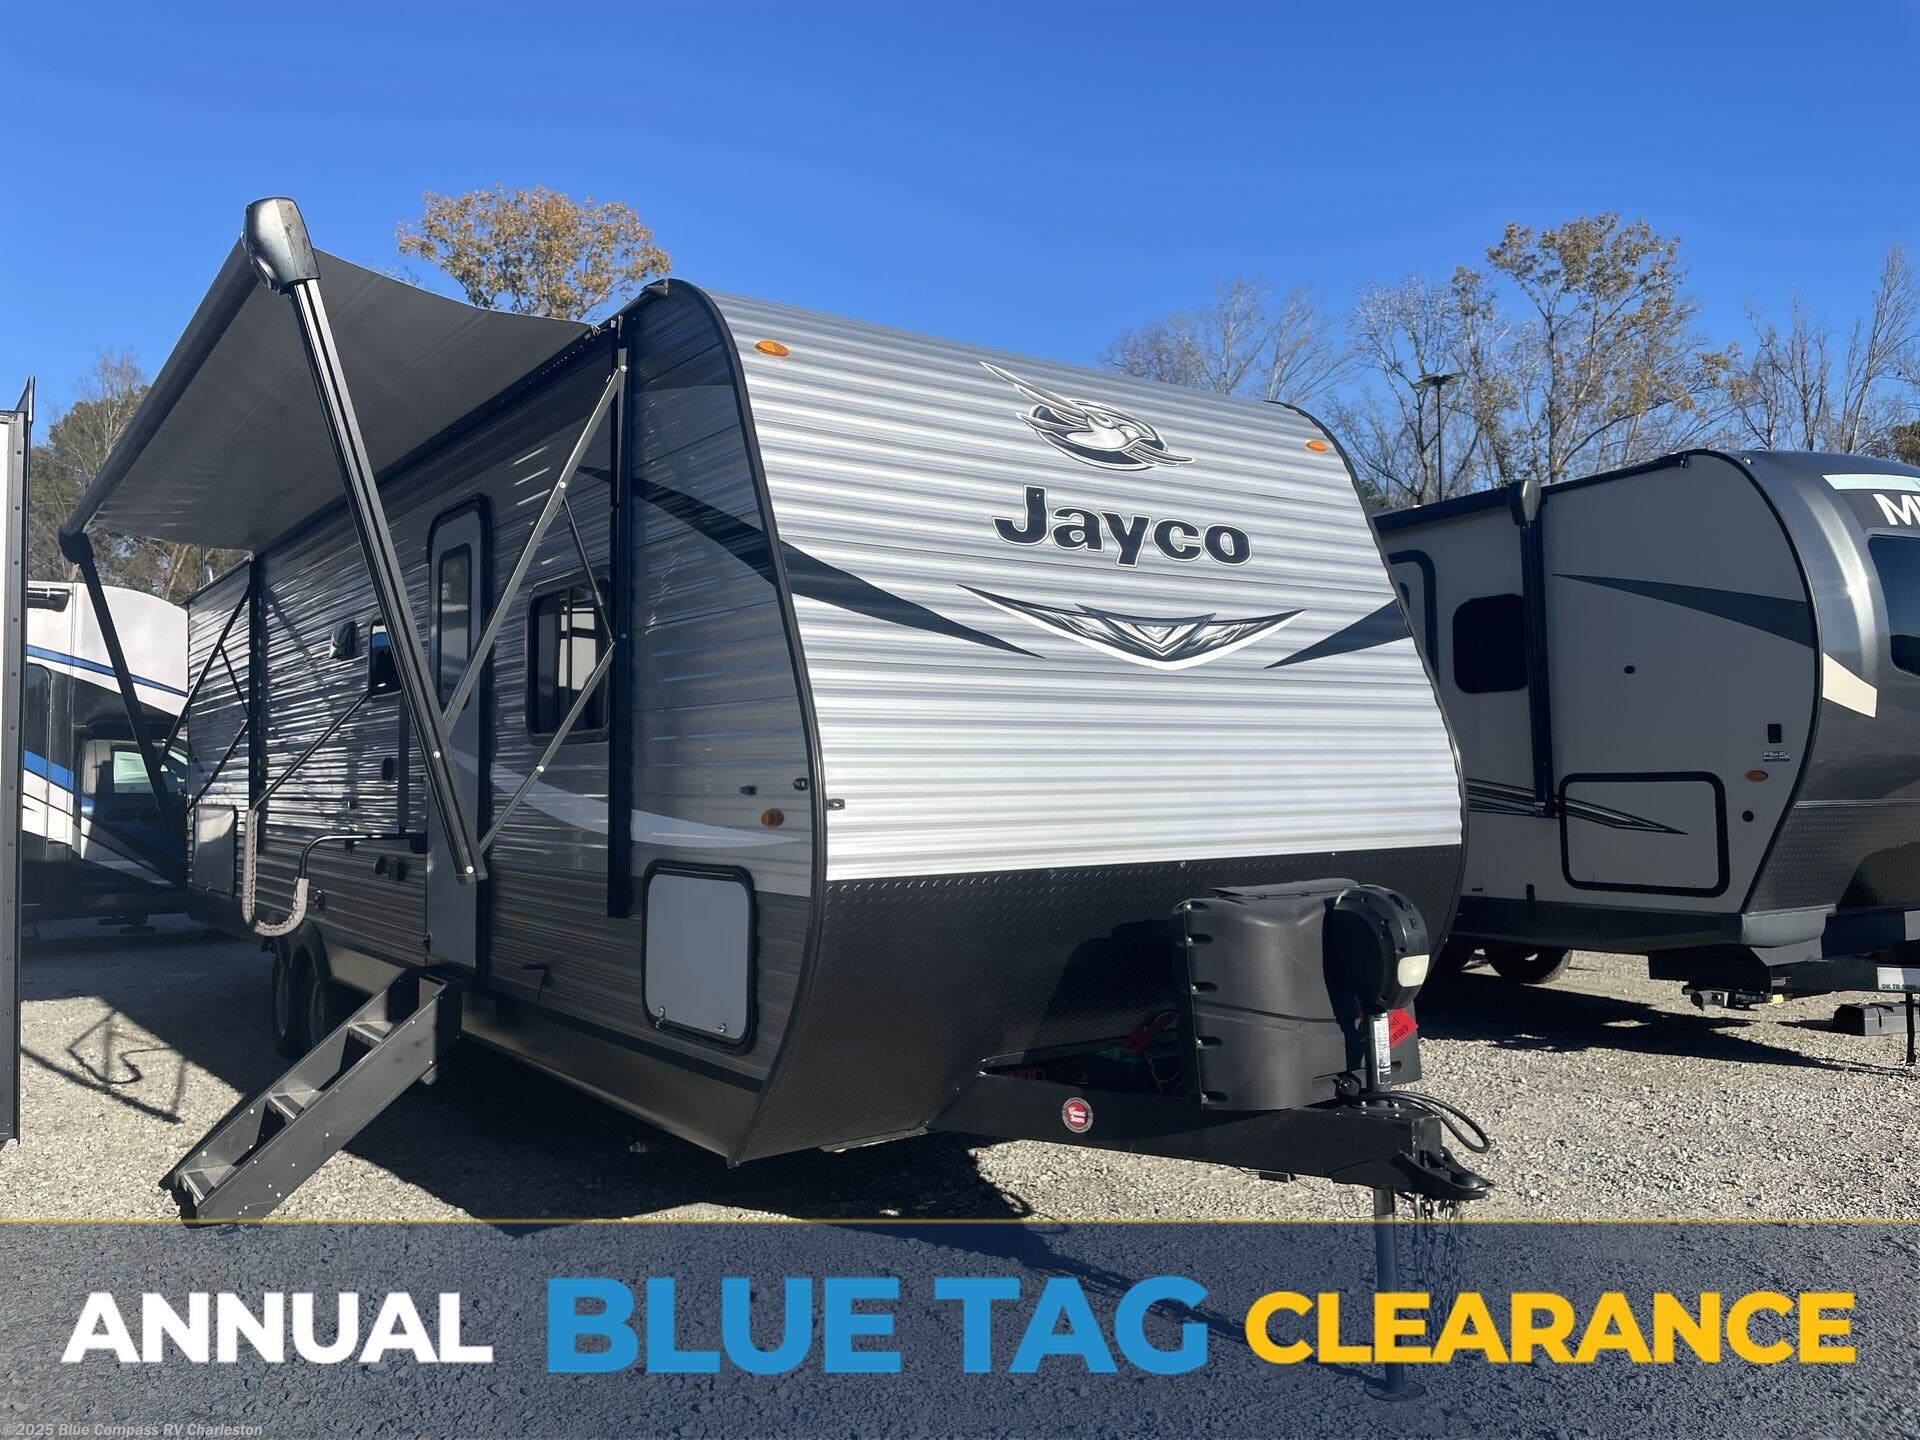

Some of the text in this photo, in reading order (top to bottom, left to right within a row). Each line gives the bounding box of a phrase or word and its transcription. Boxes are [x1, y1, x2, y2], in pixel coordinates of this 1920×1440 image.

[993, 484, 1252, 567] Jayco
[1067, 1106, 1087, 1117] Good
[1070, 1114, 1086, 1124] Sam
